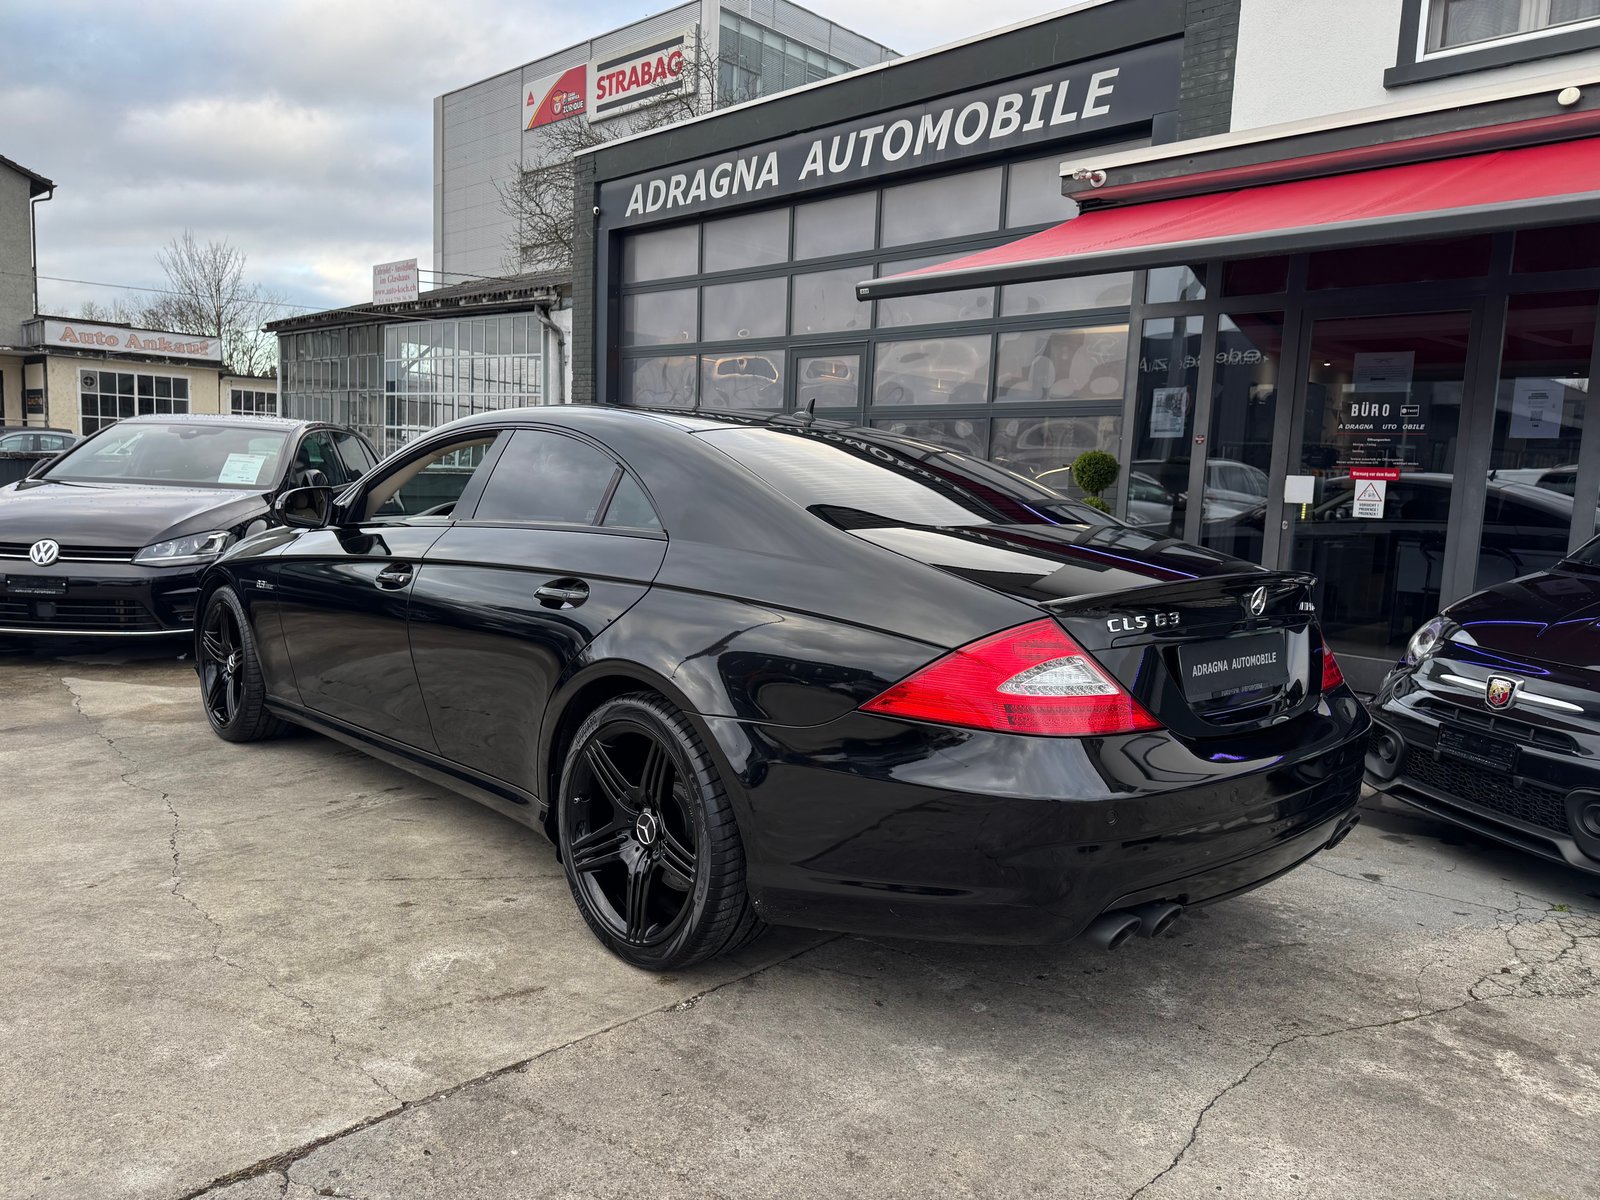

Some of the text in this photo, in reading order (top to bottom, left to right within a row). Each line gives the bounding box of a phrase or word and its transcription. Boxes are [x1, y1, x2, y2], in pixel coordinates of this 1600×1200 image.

[597, 50, 683, 100] STRABAG
[625, 67, 1120, 218] ADRAGNA AUTOMOBILE
[59, 326, 209, 356] Auto Ankauf
[1351, 402, 1390, 417] BÜRO
[1107, 612, 1180, 633] CLS 63
[1192, 651, 1277, 677] ADRAGNA AUTOMOBILE
